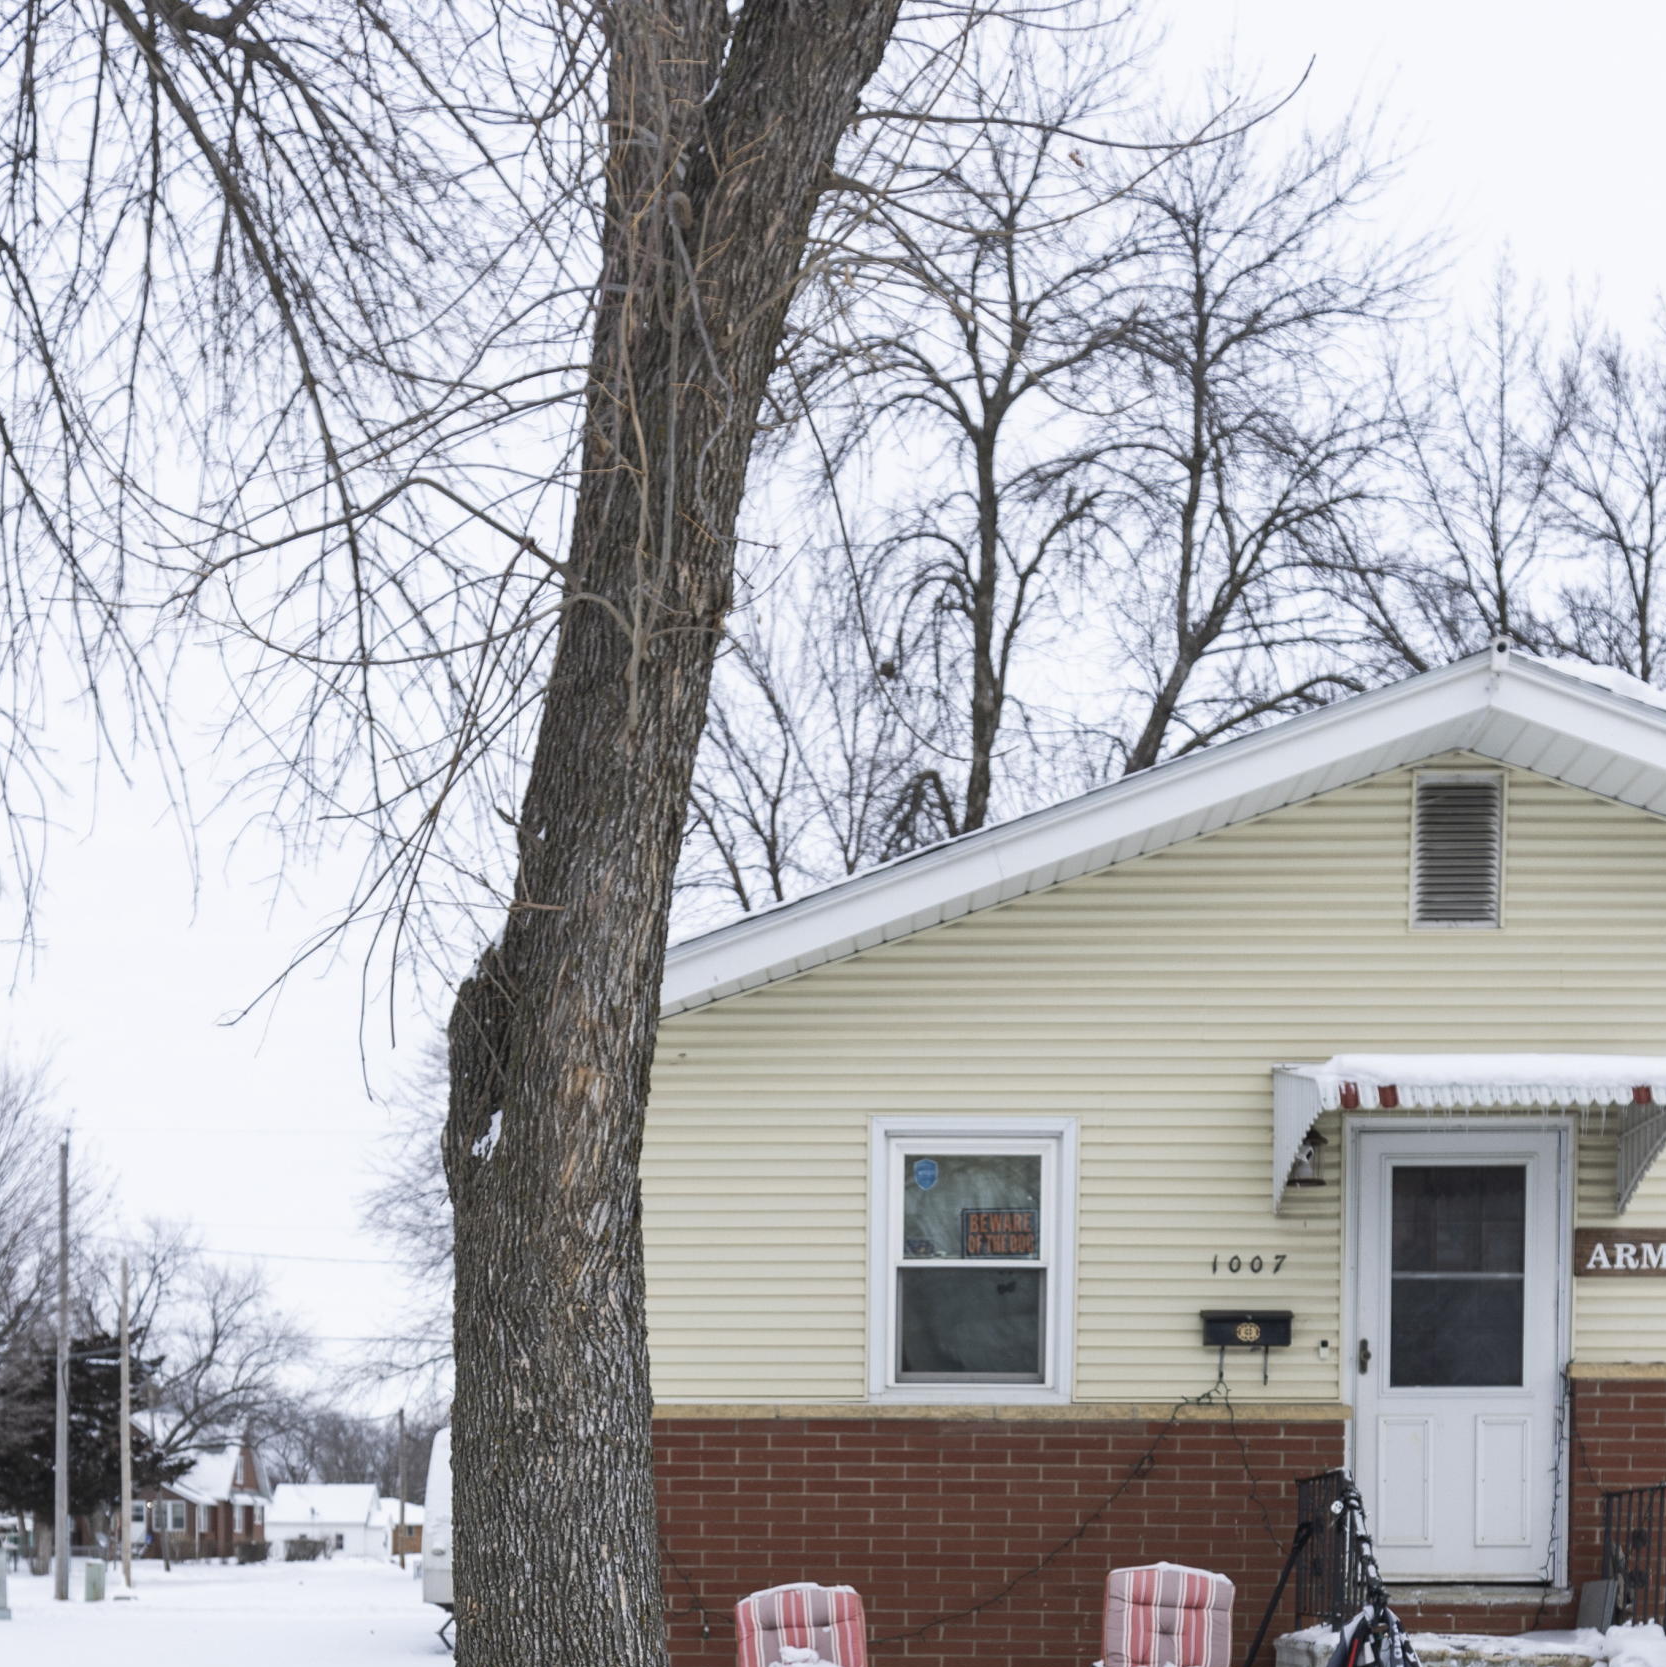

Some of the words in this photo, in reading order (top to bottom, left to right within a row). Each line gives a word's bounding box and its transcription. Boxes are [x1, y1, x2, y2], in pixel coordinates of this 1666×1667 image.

[969, 1213, 1033, 1232] BEWARE
[968, 1234, 982, 1253] OF
[986, 1234, 1006, 1253] THE
[1212, 1254, 1287, 1274] 1007
